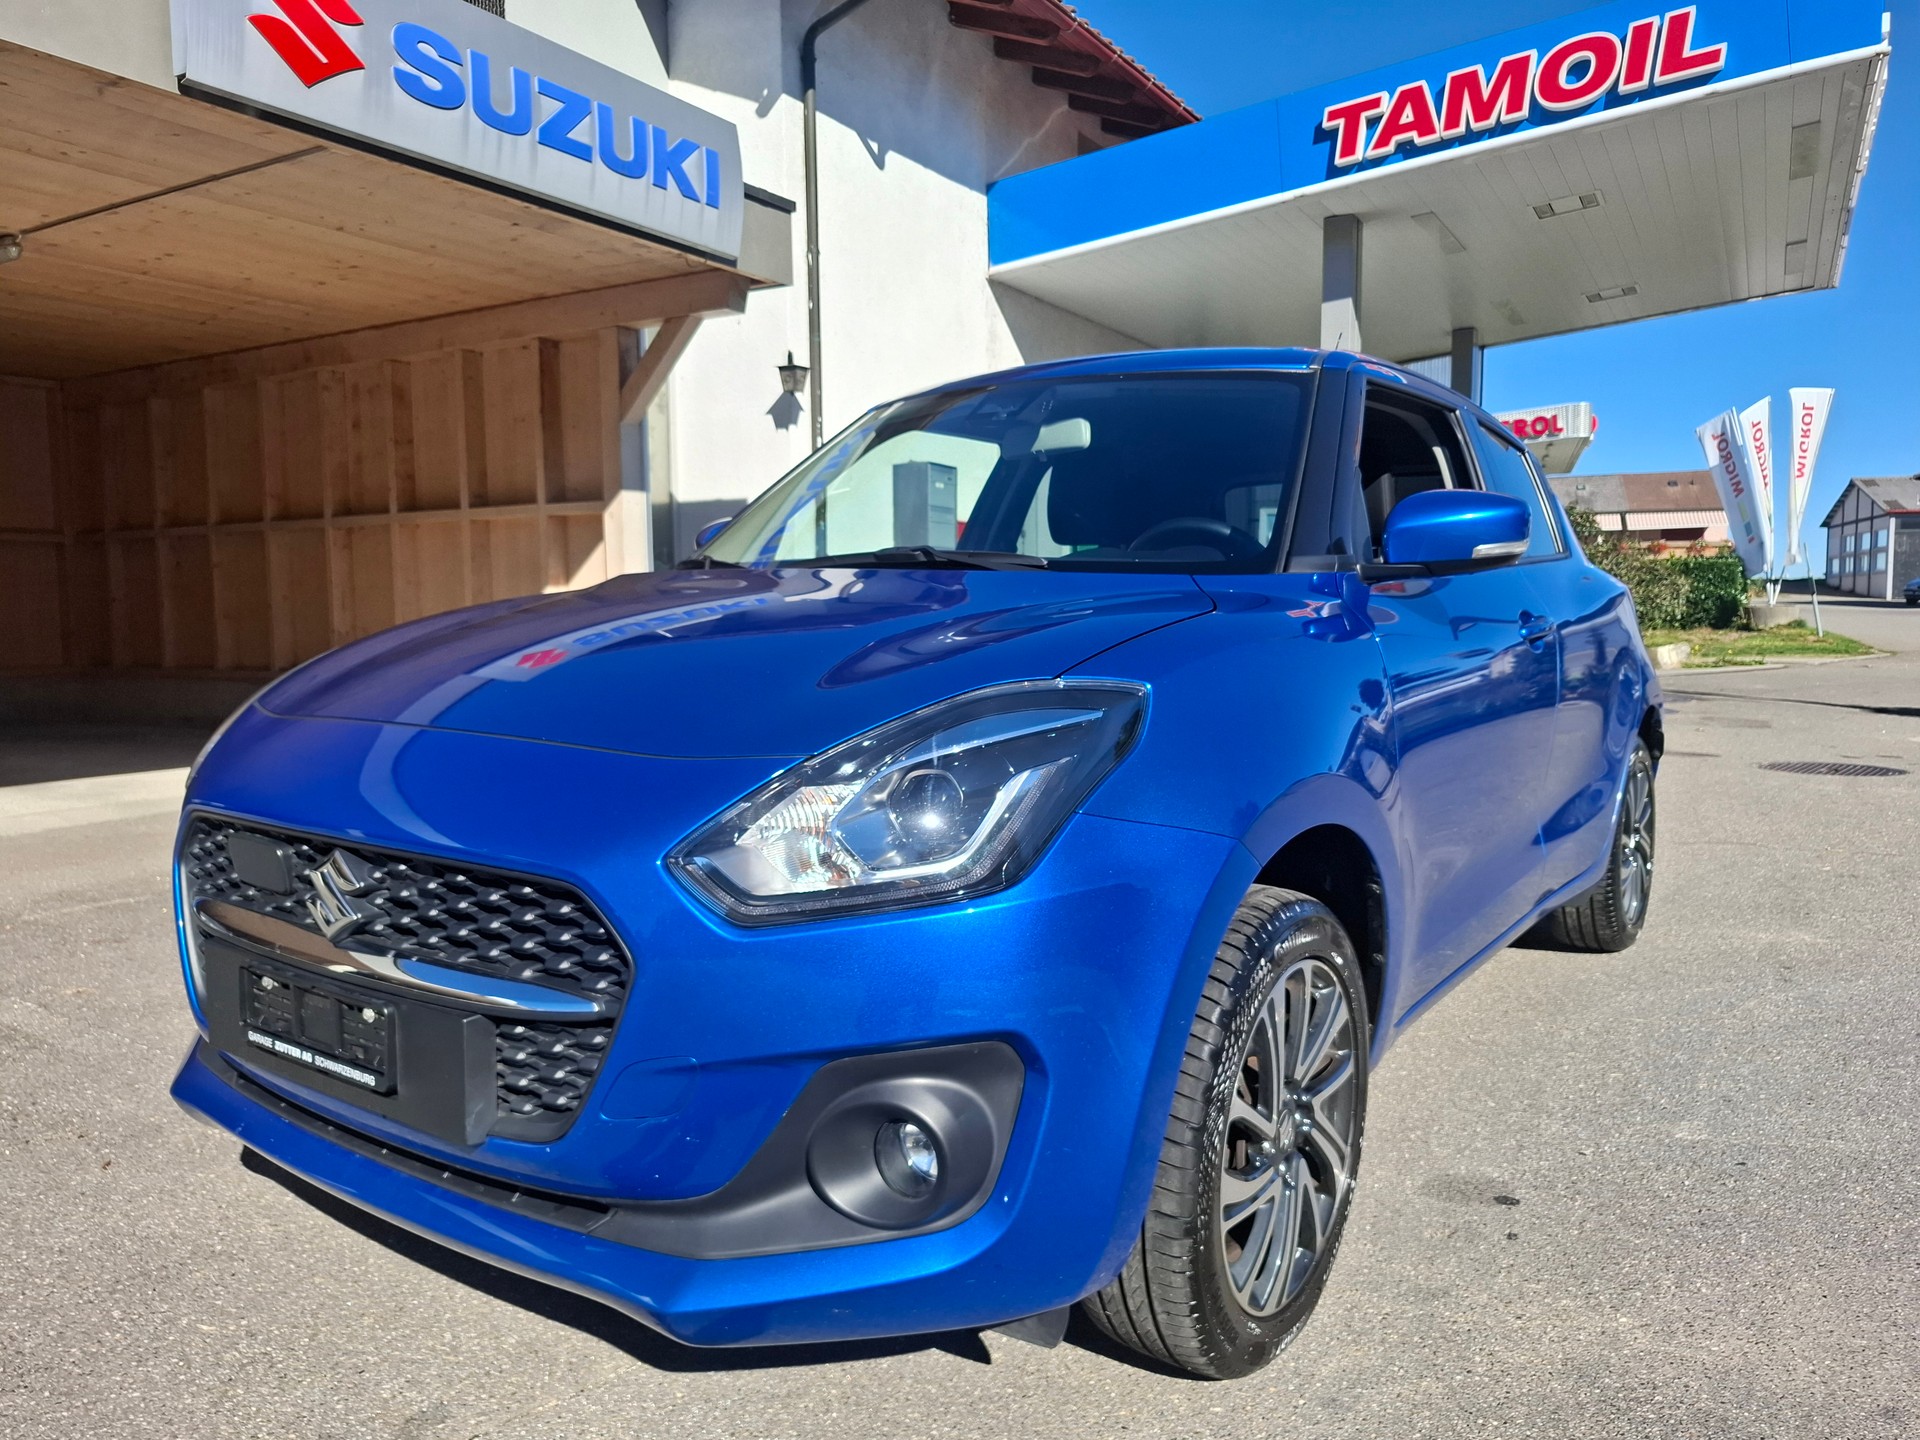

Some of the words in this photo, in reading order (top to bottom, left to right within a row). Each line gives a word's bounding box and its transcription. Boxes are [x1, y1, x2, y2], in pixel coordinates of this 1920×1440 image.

[391, 21, 720, 210] SUZUKI
[1321, 4, 1728, 168] TAMOIL
[1501, 414, 1564, 438] ROL
[248, 1030, 273, 1049] GARAGE
[314, 1055, 376, 1087] SCHWARZENBURG
